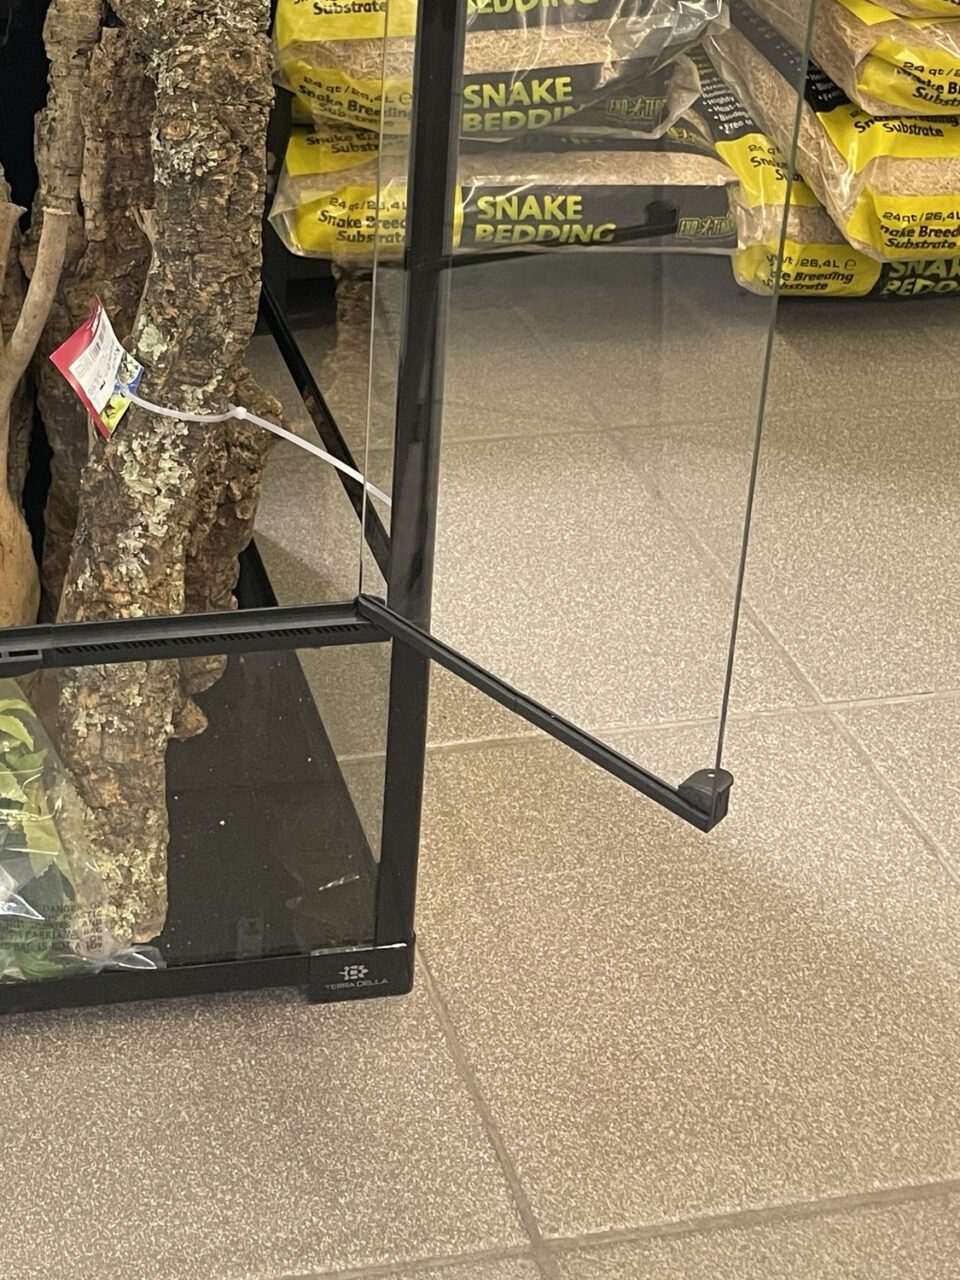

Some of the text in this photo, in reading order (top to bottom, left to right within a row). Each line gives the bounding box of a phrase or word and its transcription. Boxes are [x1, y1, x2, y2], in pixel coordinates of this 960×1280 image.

[313, 0, 387, 15] Substrate
[903, 61, 944, 76] 24 qt
[463, 77, 573, 109] SNAKE
[298, 84, 412, 118] Snake Breedin
[708, 96, 735, 106] Highly
[883, 120, 944, 137] Substrate
[476, 195, 583, 221] SNAKE
[318, 210, 407, 229] Snake Bree
[882, 211, 901, 221] 24
[474, 223, 617, 243] BEDDING
[880, 225, 960, 238] nake Breed
[884, 238, 957, 249] Substrate
[800, 258, 840, 269] 26,4L
[795, 272, 854, 285] Breeding
[325, 978, 388, 991] TERRA DELLA
